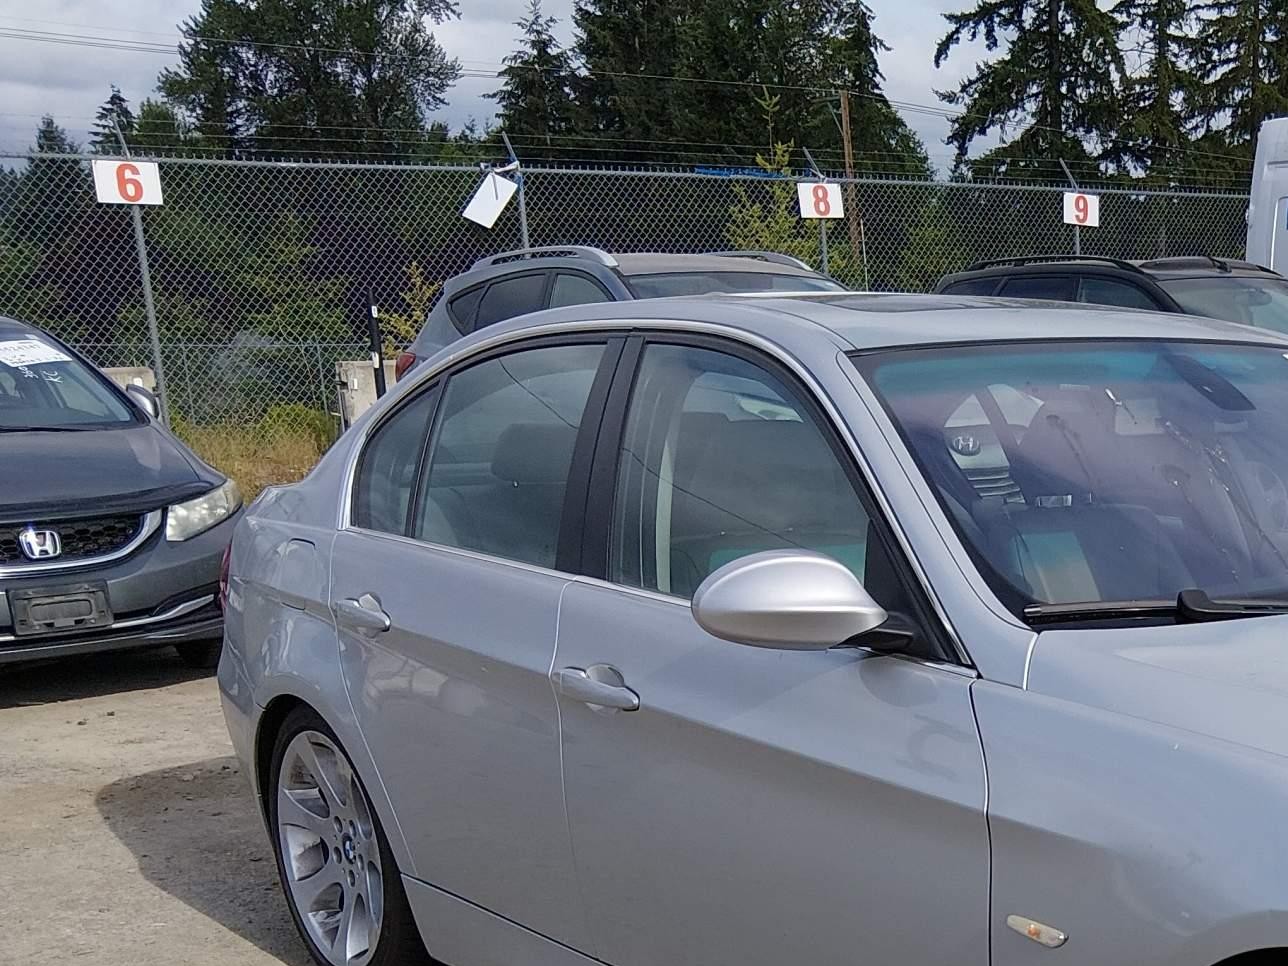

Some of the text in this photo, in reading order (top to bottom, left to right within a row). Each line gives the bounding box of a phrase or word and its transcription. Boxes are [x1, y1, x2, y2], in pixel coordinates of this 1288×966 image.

[116, 163, 143, 202] 6
[813, 185, 830, 216] 8
[1075, 195, 1088, 223] 9
